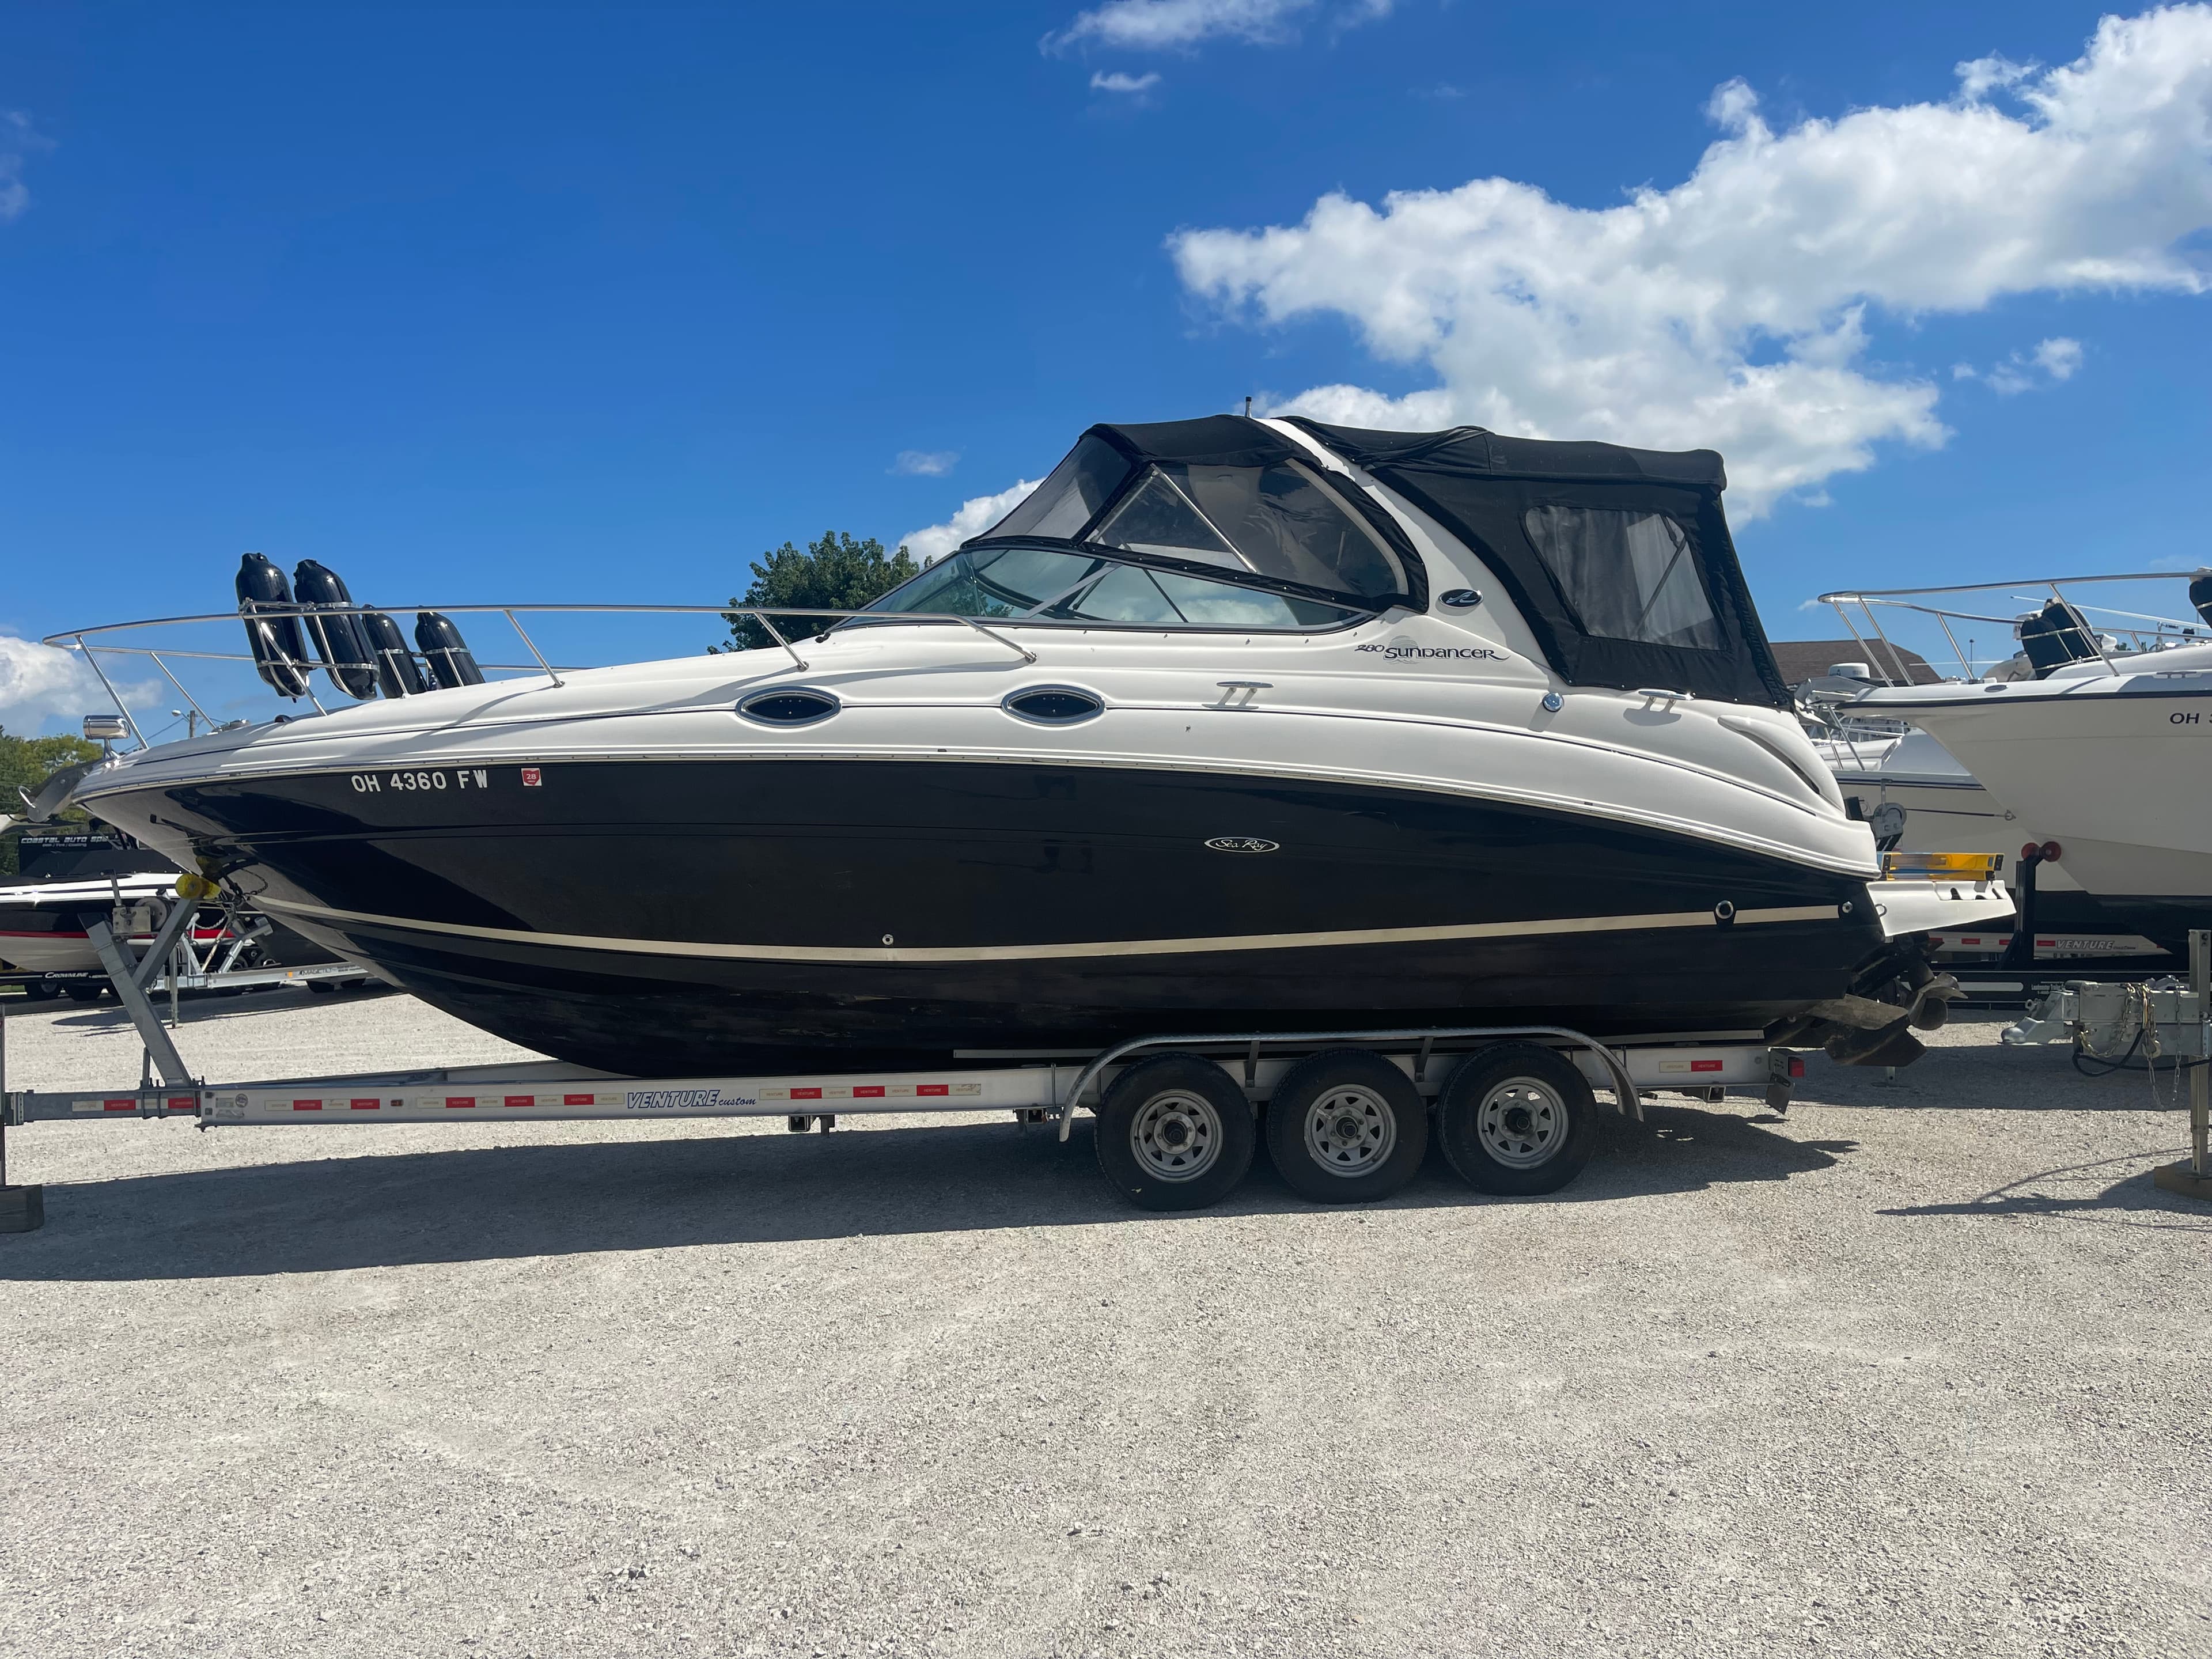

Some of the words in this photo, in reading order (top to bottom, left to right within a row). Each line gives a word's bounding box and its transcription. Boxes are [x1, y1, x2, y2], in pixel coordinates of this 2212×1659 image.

[1355, 644, 1385, 653] 280
[2170, 713, 2200, 724] OH
[351, 774, 381, 792] OH
[390, 771, 447, 790] 4360
[1215, 839, 1238, 848] Sea
[1242, 839, 1267, 851] Ray
[2056, 940, 2115, 950] VENTURE
[627, 1089, 720, 1109] VENTURE
[719, 1096, 756, 1106] custom
